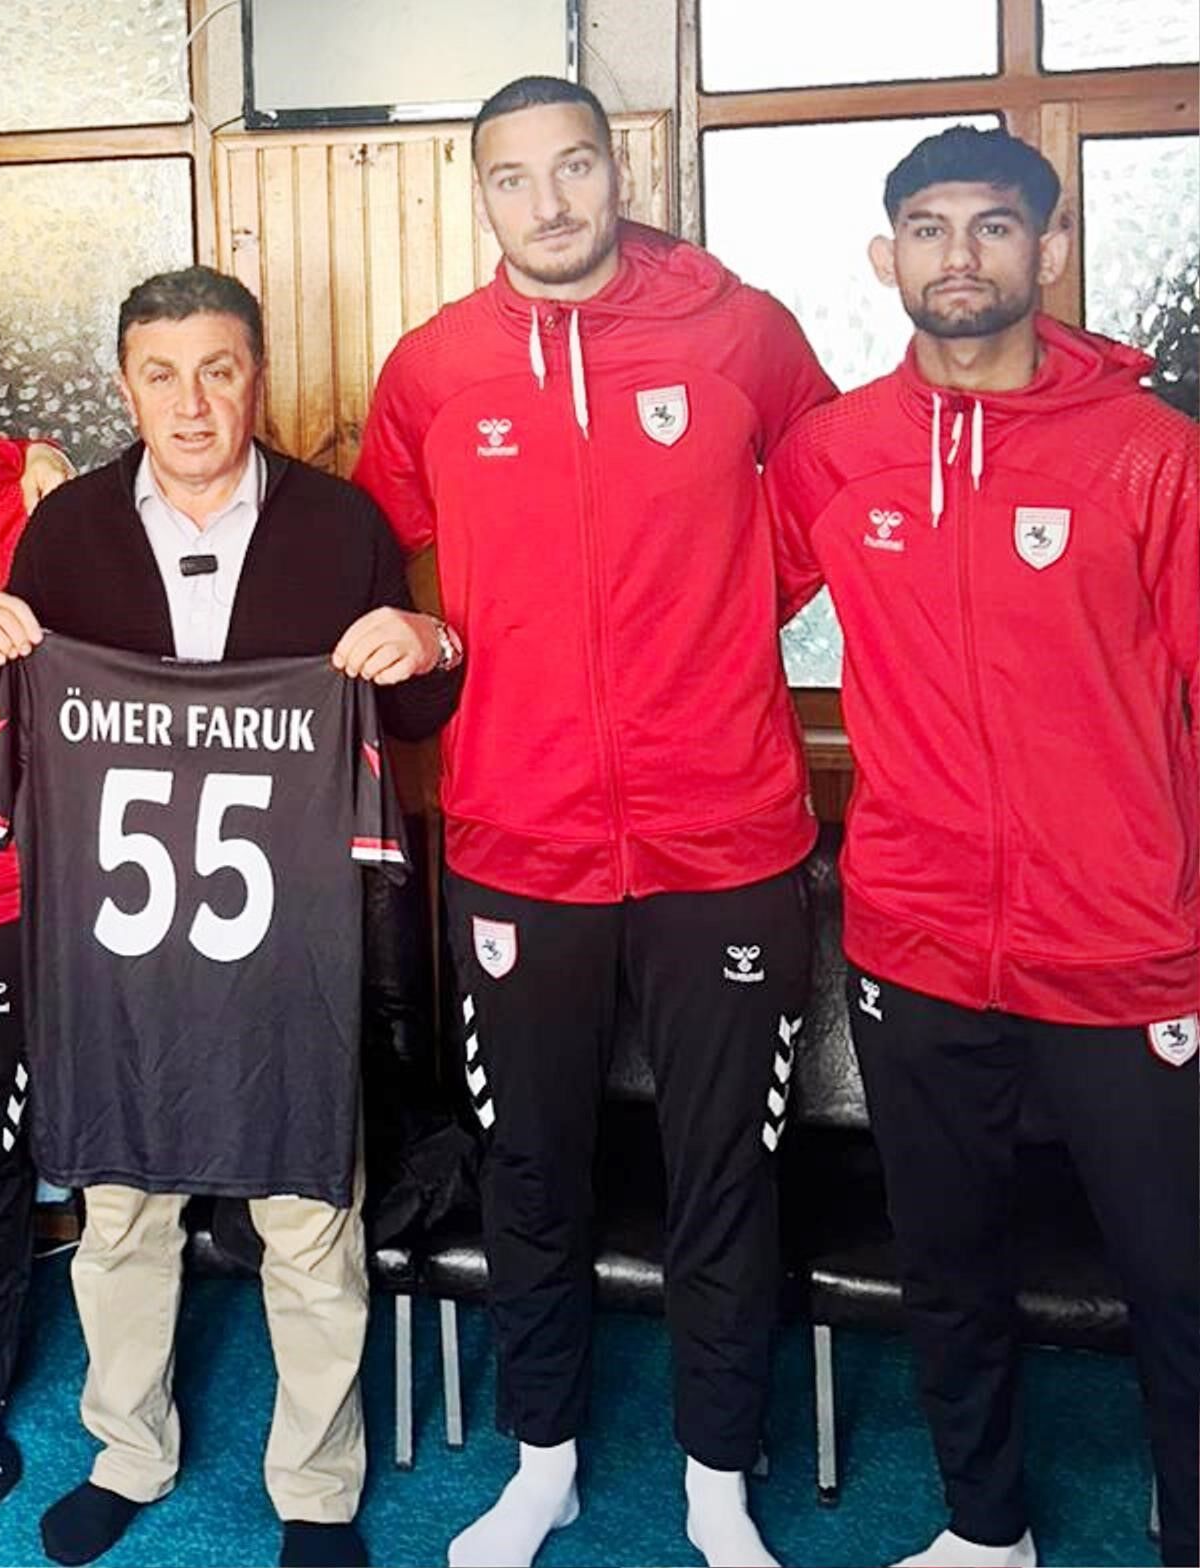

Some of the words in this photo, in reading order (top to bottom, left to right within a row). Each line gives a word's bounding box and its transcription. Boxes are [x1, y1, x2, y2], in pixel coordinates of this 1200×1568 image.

[59, 687, 173, 746] ÖMER
[187, 704, 315, 752] FARUK
[93, 767, 275, 962] 55
